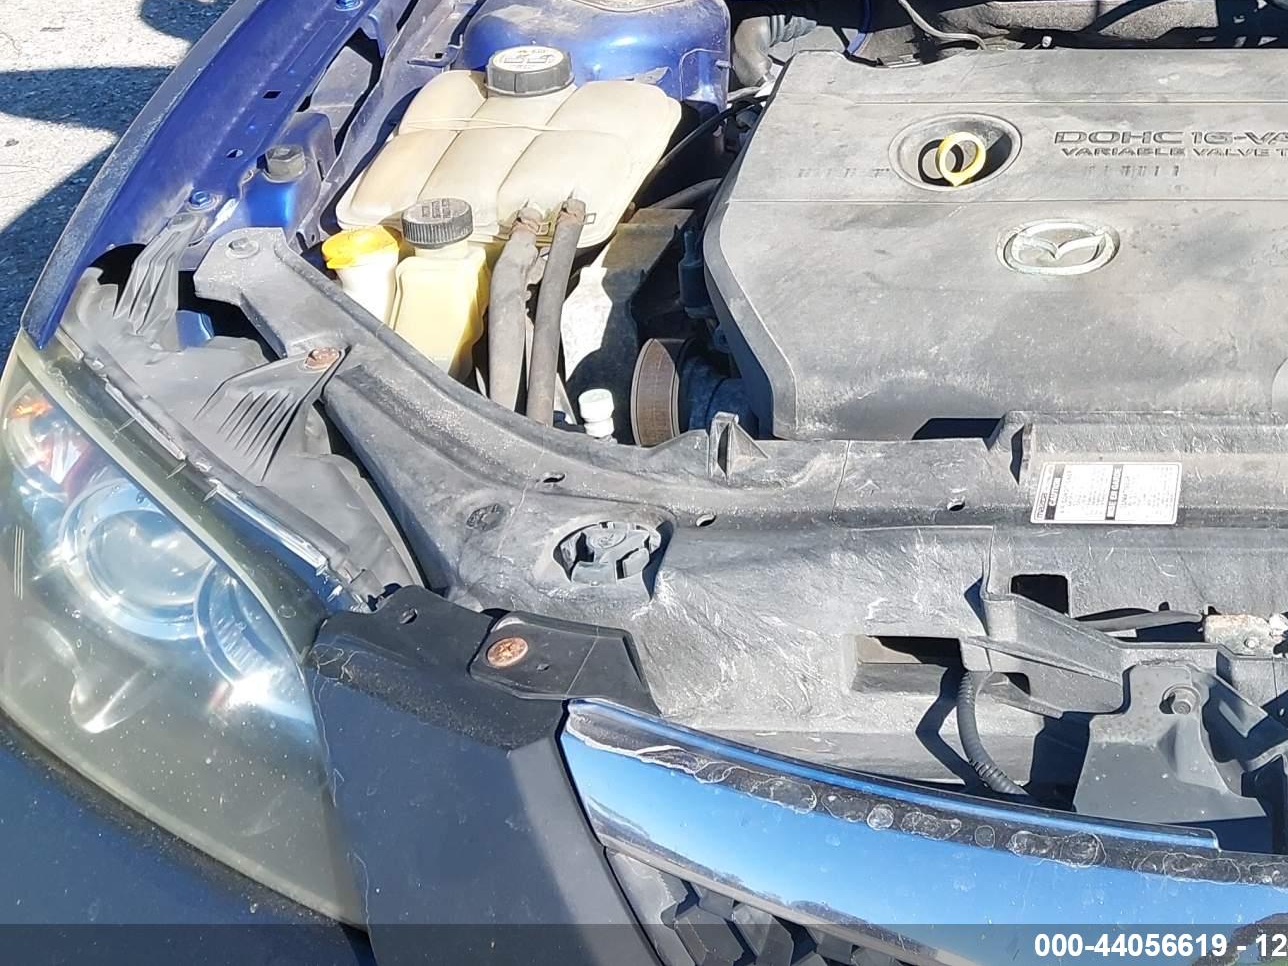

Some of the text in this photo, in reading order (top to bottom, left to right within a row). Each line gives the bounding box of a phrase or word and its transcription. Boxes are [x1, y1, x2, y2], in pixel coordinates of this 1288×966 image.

[1054, 130, 1184, 145] DOHC
[1061, 147, 1185, 157] VARIABLE
[1192, 147, 1270, 157] VALVE
